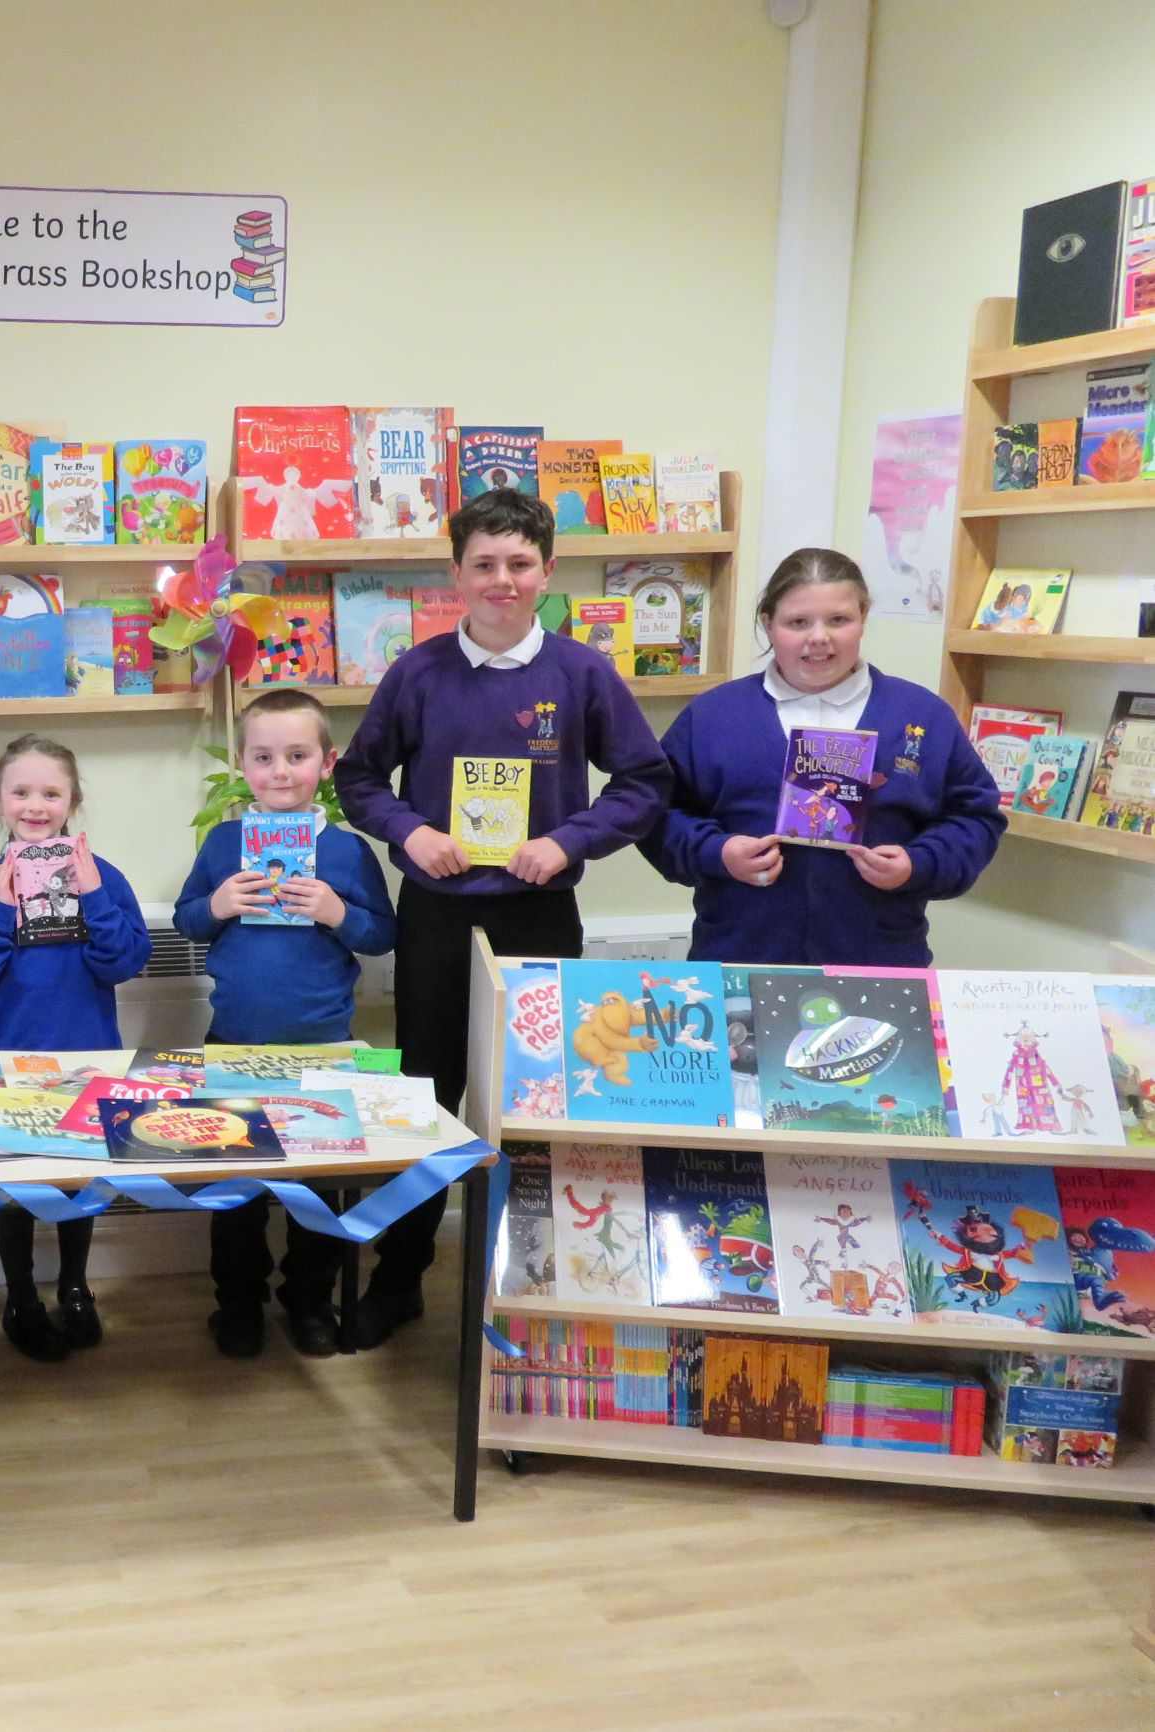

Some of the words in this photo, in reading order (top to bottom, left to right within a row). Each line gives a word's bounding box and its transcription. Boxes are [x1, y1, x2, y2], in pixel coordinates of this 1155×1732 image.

[35, 210, 64, 239] to
[77, 209, 128, 240] the
[81, 259, 231, 300] Bookshop
[1088, 385, 1130, 400] Micro
[380, 430, 426, 459] BEAR
[566, 448, 595, 460] TWO
[53, 463, 73, 471] The
[75, 463, 95, 472] Boy
[380, 462, 426, 475] SPOTTING
[543, 461, 600, 474] MONSTE
[634, 608, 654, 619] The
[657, 609, 678, 619] Sun
[639, 623, 650, 633] in
[653, 622, 670, 633] Me
[794, 738, 821, 755] THE
[824, 736, 868, 760] GREAT
[1034, 740, 1051, 753] Out
[794, 755, 862, 779] CHOCOPLOT
[1038, 755, 1064, 767] Count
[463, 761, 490, 785] BEE
[493, 762, 525, 785] BOY
[244, 816, 271, 825] DANNY
[273, 816, 314, 825] WALLACE
[243, 825, 313, 855] HAMISH
[21, 845, 51, 858] ISADORA
[961, 981, 1022, 999] Quentin
[1025, 979, 1077, 999] Blake
[517, 984, 558, 1010] mor
[644, 989, 714, 1049] NO
[648, 1050, 719, 1071] MORE
[818, 1051, 884, 1081] Martian
[648, 1070, 720, 1085] CUDDLES!
[608, 1095, 636, 1107] JANE
[641, 1096, 695, 1108] CHAPMAN
[146, 1116, 227, 1132] SWITCHED
[196, 1124, 228, 1135] THE
[183, 1134, 221, 1145] SUN
[566, 1157, 596, 1171] MRS
[677, 1151, 726, 1173] Aliens
[575, 1172, 594, 1183] ON
[985, 1162, 1022, 1181] Love
[521, 1175, 544, 1186] One
[674, 1170, 766, 1200] Underpant
[793, 1175, 874, 1193] ANGELO
[514, 1185, 549, 1200] Snowy
[930, 1180, 1023, 1206] Underpants
[518, 1198, 547, 1211] Night
[1018, 1408, 1059, 1421] Storybook
